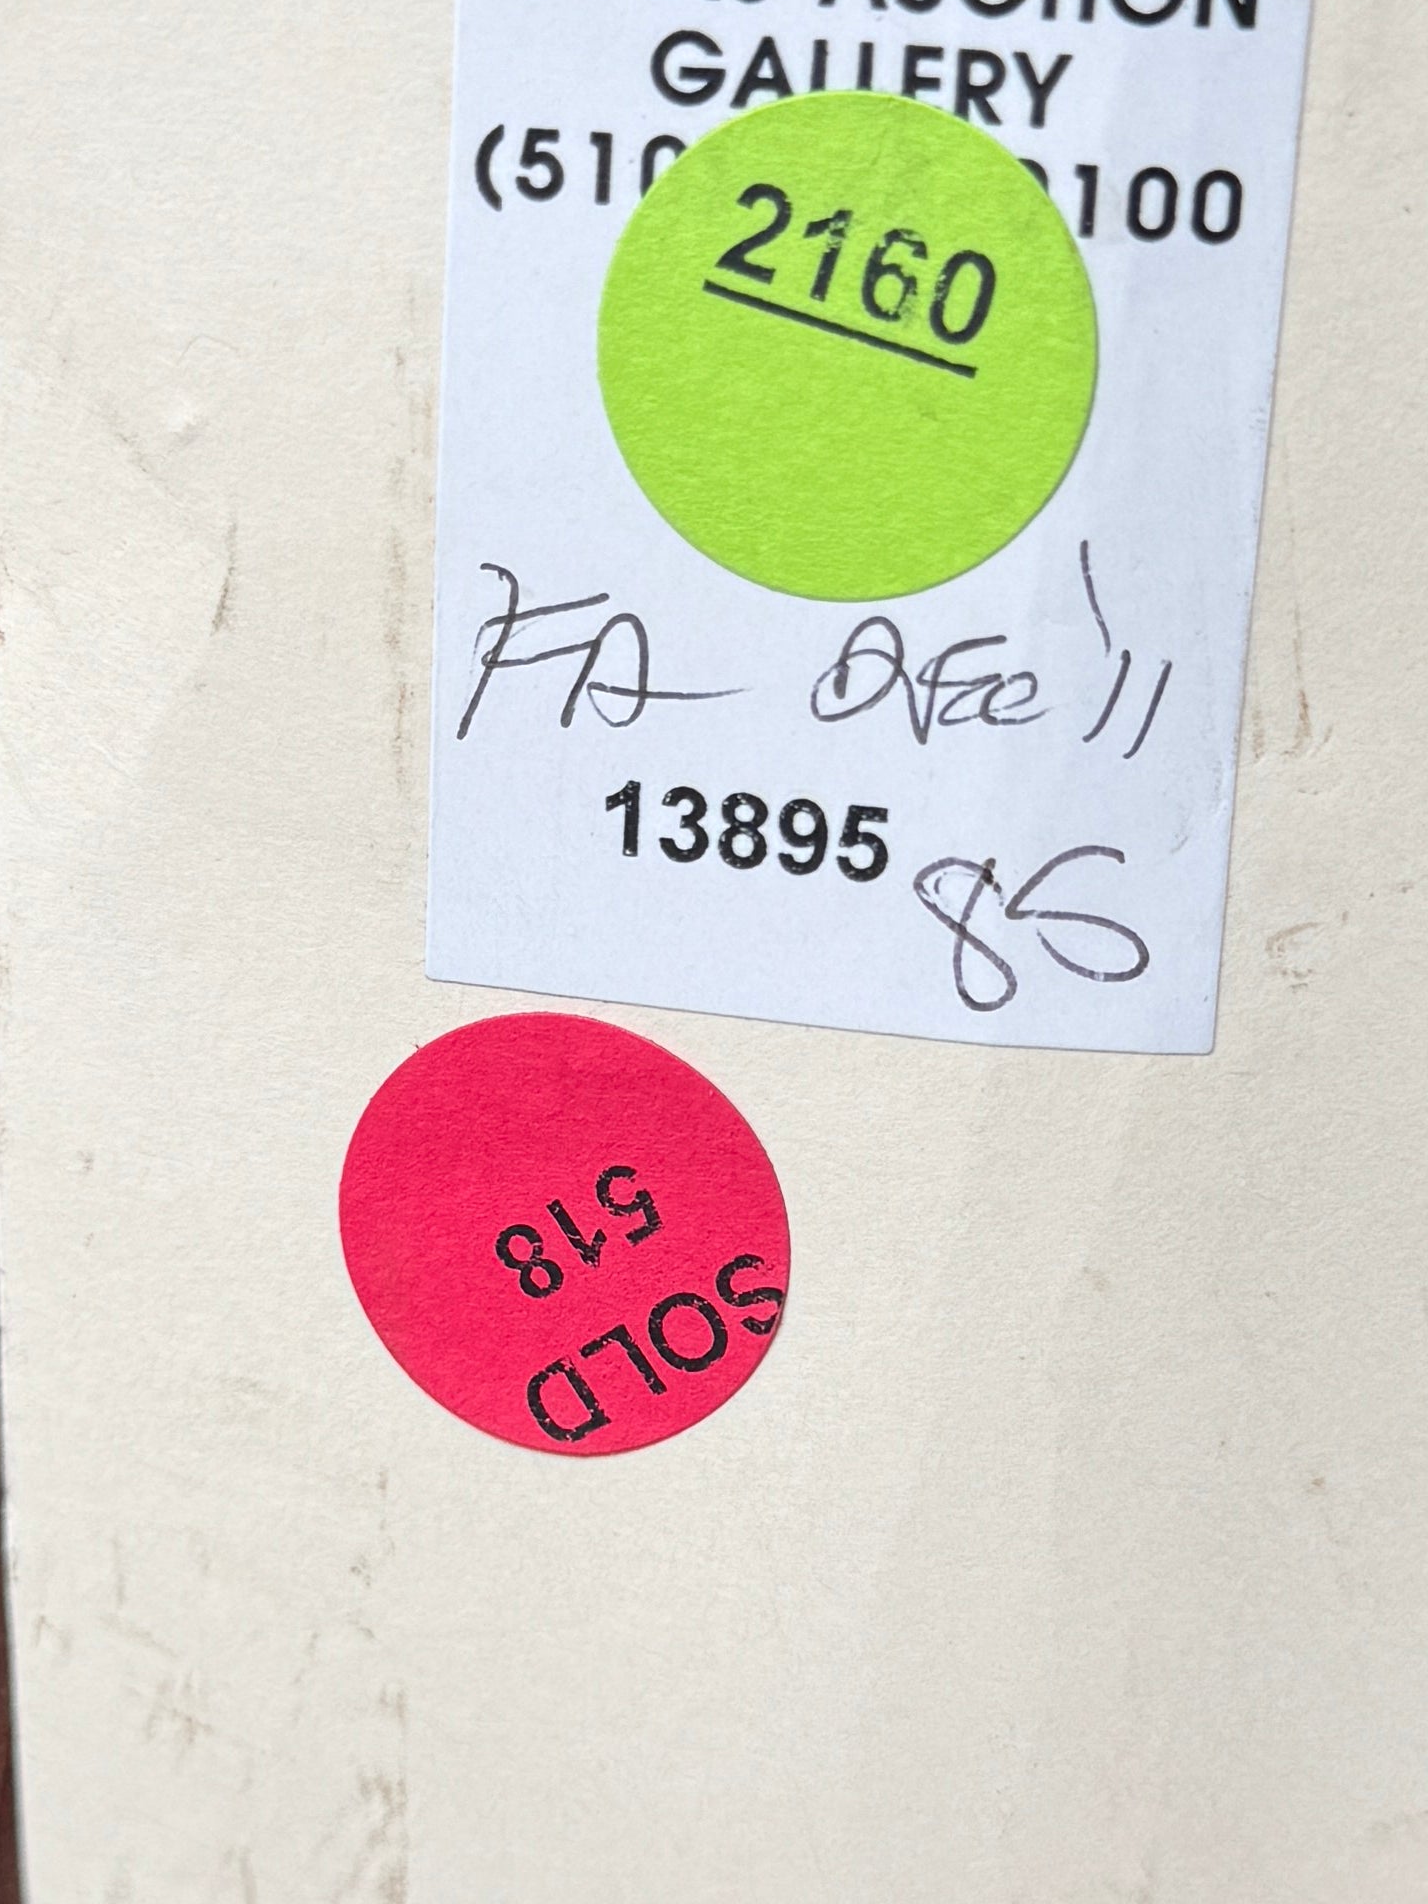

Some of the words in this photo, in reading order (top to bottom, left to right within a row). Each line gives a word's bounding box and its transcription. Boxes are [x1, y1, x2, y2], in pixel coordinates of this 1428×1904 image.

[715, 182, 997, 345] 2160
[1018, 157, 1243, 246] 100
[606, 781, 888, 881] 13895
[495, 1164, 663, 1298] 518
[527, 1253, 784, 1443] SOLD
